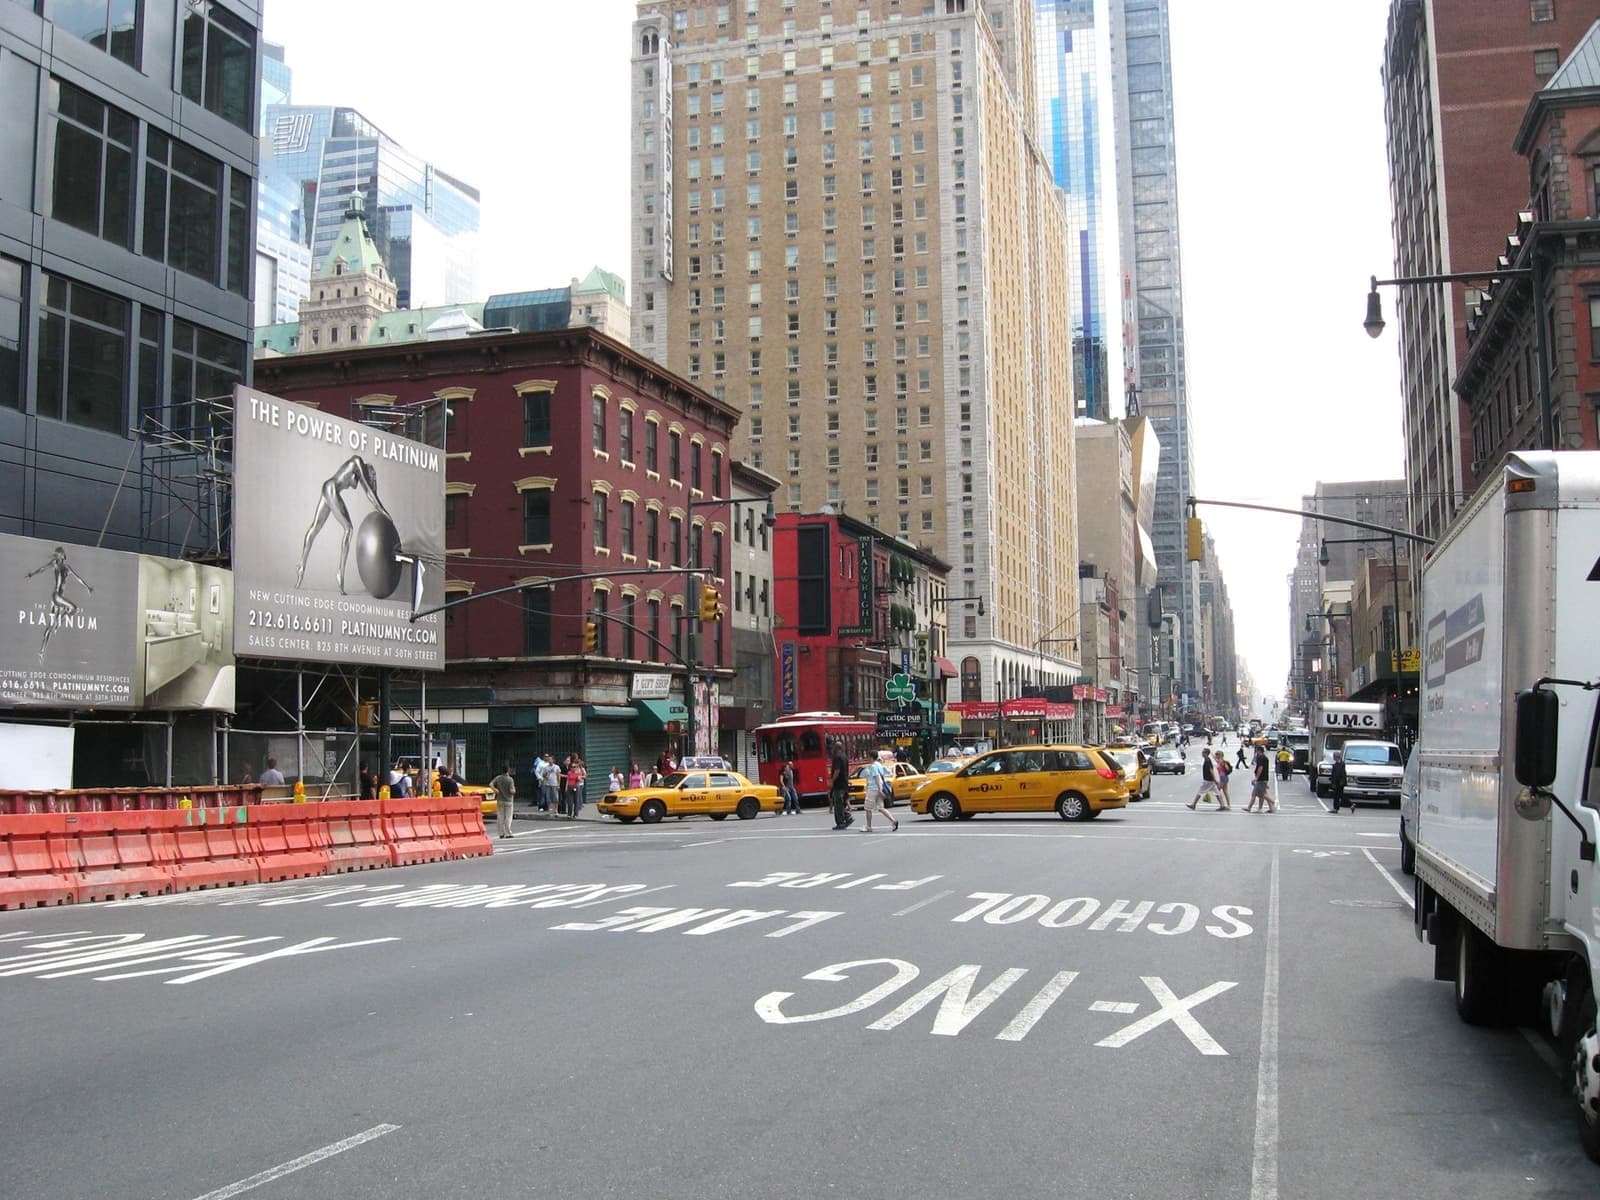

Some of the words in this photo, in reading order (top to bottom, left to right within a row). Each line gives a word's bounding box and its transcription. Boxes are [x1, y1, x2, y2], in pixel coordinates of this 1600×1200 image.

[250, 398, 279, 427] THE
[287, 410, 342, 445] POWER
[349, 430, 368, 451] OF
[374, 437, 439, 472] PLATINUM
[249, 589, 271, 601] NEW
[274, 593, 311, 607] CUTTING
[314, 598, 335, 610] EDGE
[337, 601, 394, 617] CONDOMINIUM
[19, 610, 98, 631] PLATINUM
[249, 609, 332, 633] 212.616.6611
[341, 620, 437, 645] PLATINUMNYC.COM
[249, 635, 275, 648] SALES
[351, 644, 381, 656] AVENUE
[384, 647, 392, 657] AT
[414, 650, 437, 661] STREET
[49, 672, 95, 682] CONDOMINIUM
[53, 681, 130, 694] PLATINUMNYC.COM
[1326, 713, 1377, 727] U.M.C.
[725, 872, 944, 890] FIRE
[547, 907, 846, 938] LANE
[951, 892, 1254, 939] SCHOOL
[754, 958, 1240, 1057] X-ING
